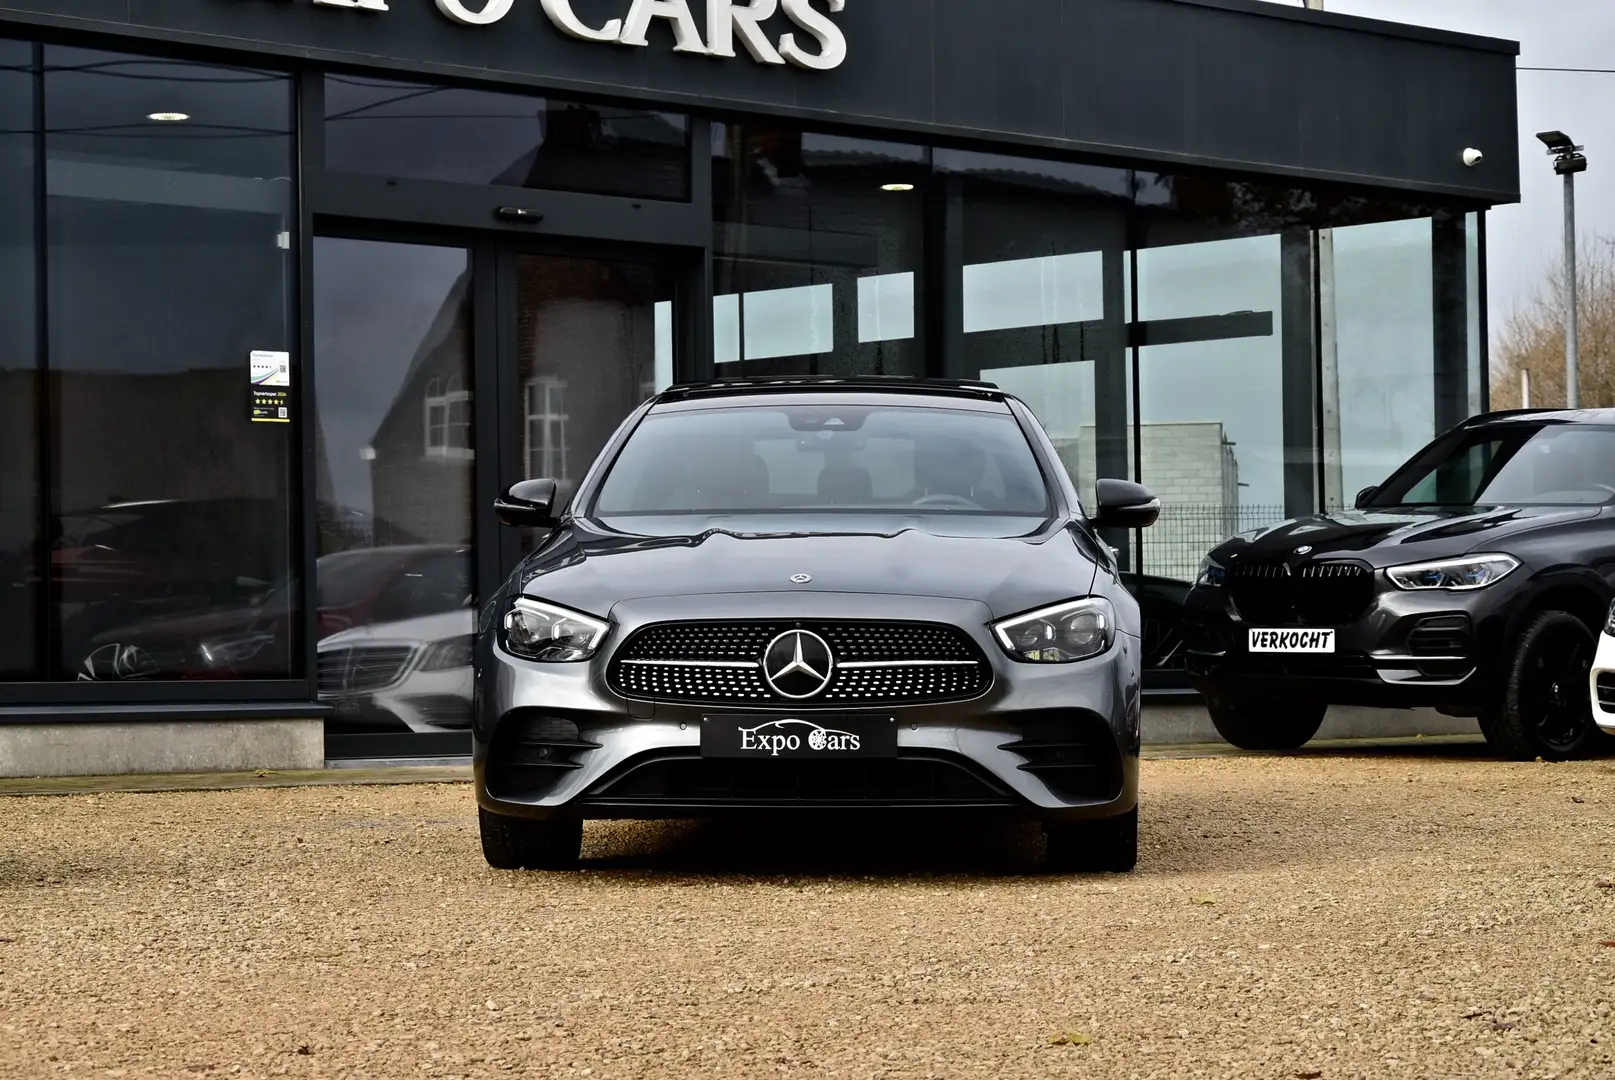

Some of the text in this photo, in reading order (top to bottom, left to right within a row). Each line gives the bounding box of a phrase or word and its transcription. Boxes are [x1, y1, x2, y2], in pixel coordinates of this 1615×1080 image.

[1252, 631, 1333, 649] VERKOCHT
[739, 728, 861, 756] Expo Cars
